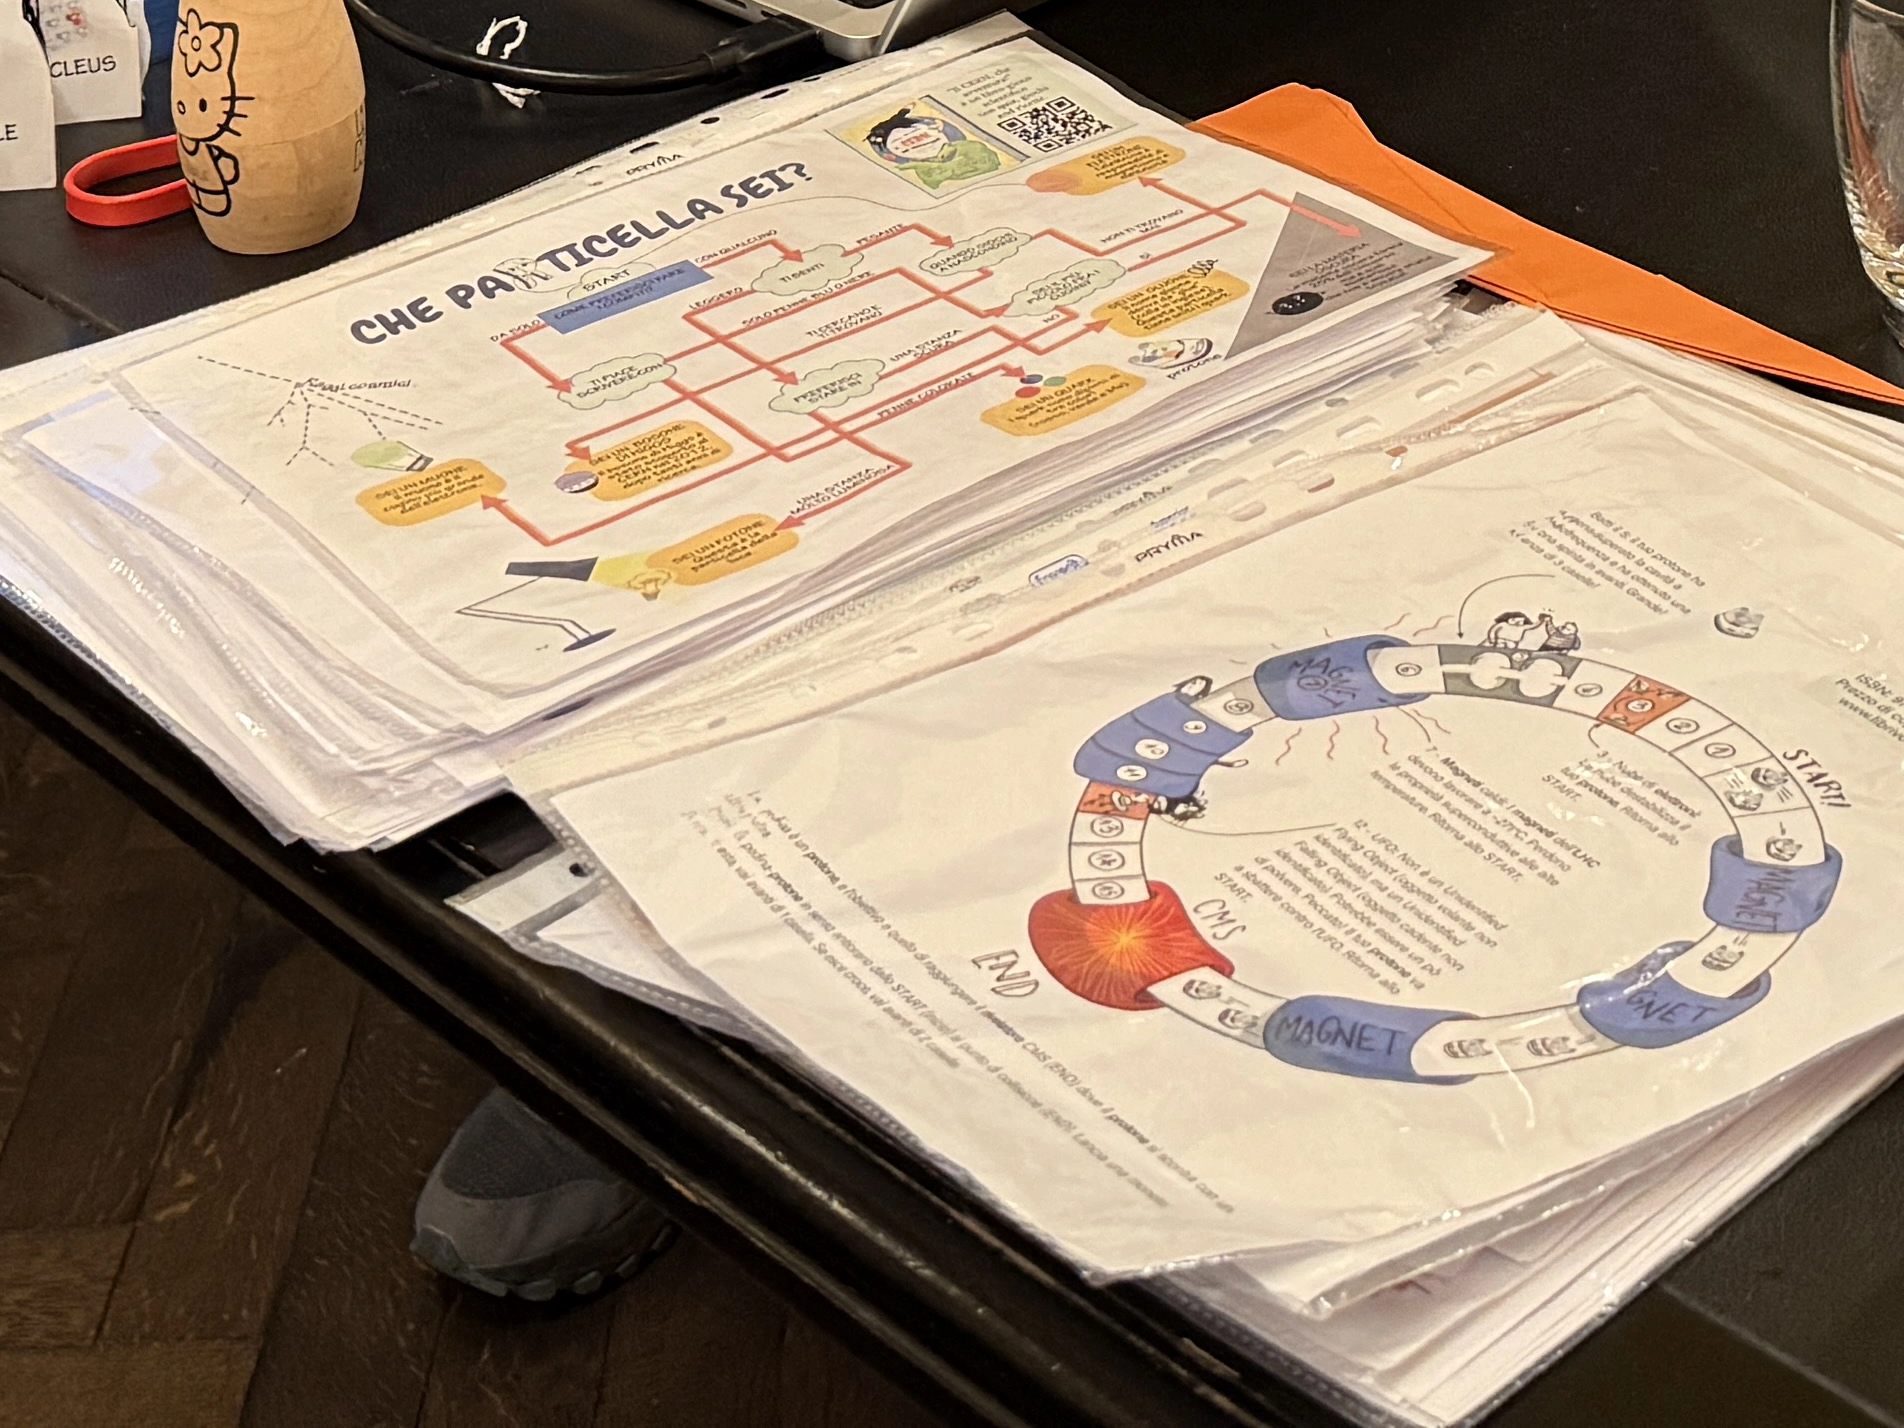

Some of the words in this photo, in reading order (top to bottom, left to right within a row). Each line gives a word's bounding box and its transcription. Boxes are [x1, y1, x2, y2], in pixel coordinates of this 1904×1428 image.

[50, 55, 117, 78] CLEUS
[855, 223, 905, 245] PESANTE
[350, 295, 444, 345] CHE
[444, 193, 725, 311] PARTICELLA
[719, 160, 814, 209] SEI?
[581, 268, 632, 293] START
[688, 286, 744, 310] LEGGERO
[825, 466, 876, 496] STANZA
[788, 493, 834, 516] MOLTO
[1135, 530, 1204, 563] PRYMA
[1835, 678, 1878, 706] Prezzo
[1877, 701, 1894, 715] di
[1855, 673, 1893, 698] ISBN:
[1783, 748, 1852, 809] START!
[1193, 898, 1246, 941] CMS
[971, 948, 1040, 998] END
[1626, 989, 1720, 1026] GNET
[1274, 1014, 1411, 1058] MAGNET
